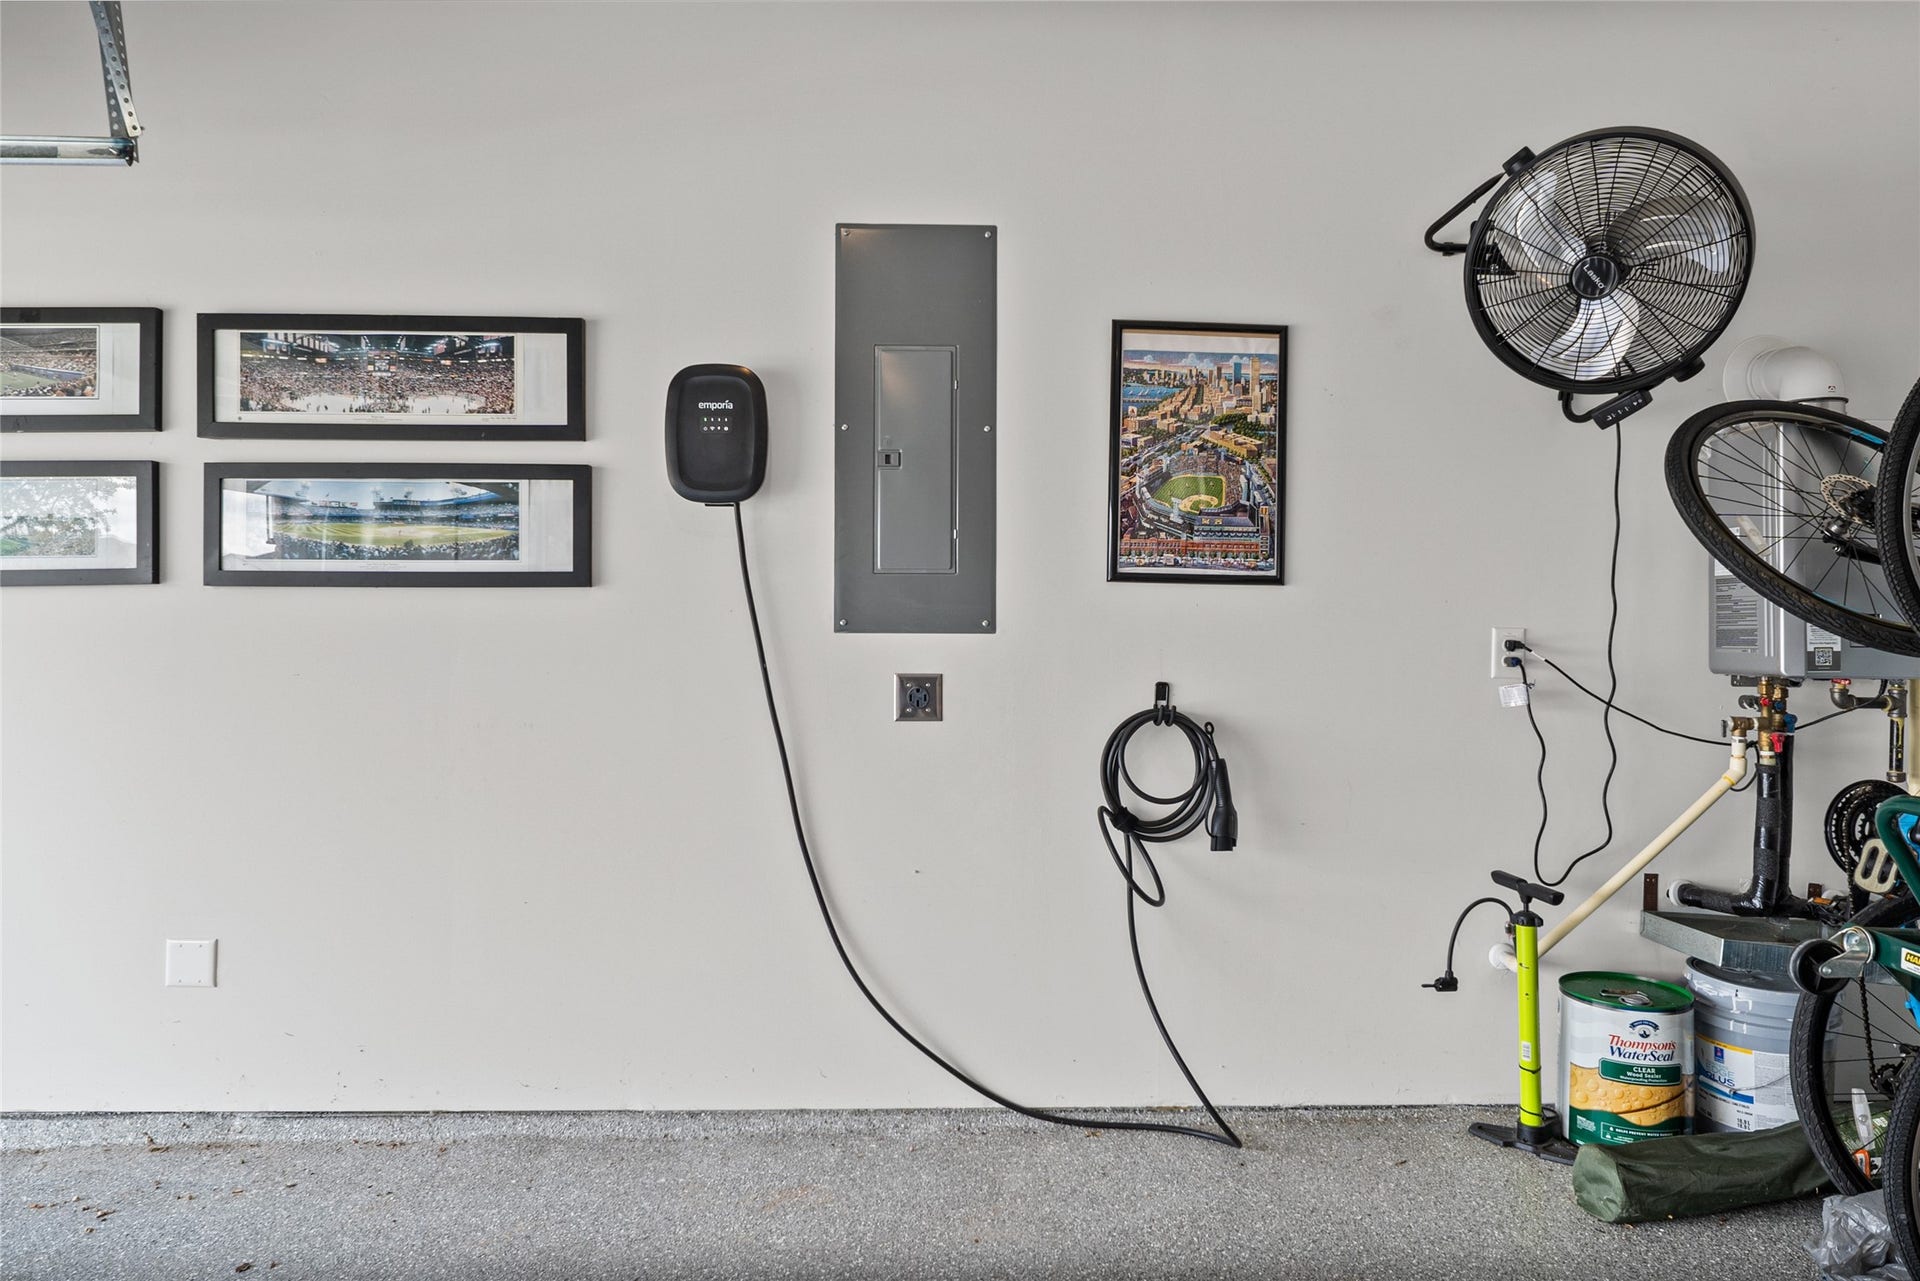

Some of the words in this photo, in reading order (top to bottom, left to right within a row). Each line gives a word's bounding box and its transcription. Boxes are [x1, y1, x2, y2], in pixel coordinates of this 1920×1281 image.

[1608, 1034, 1677, 1053] Thompson's
[1609, 1045, 1675, 1062] WaterSeal
[1626, 1071, 1643, 1079] Wood
[1632, 1066, 1656, 1074] CLEAR
